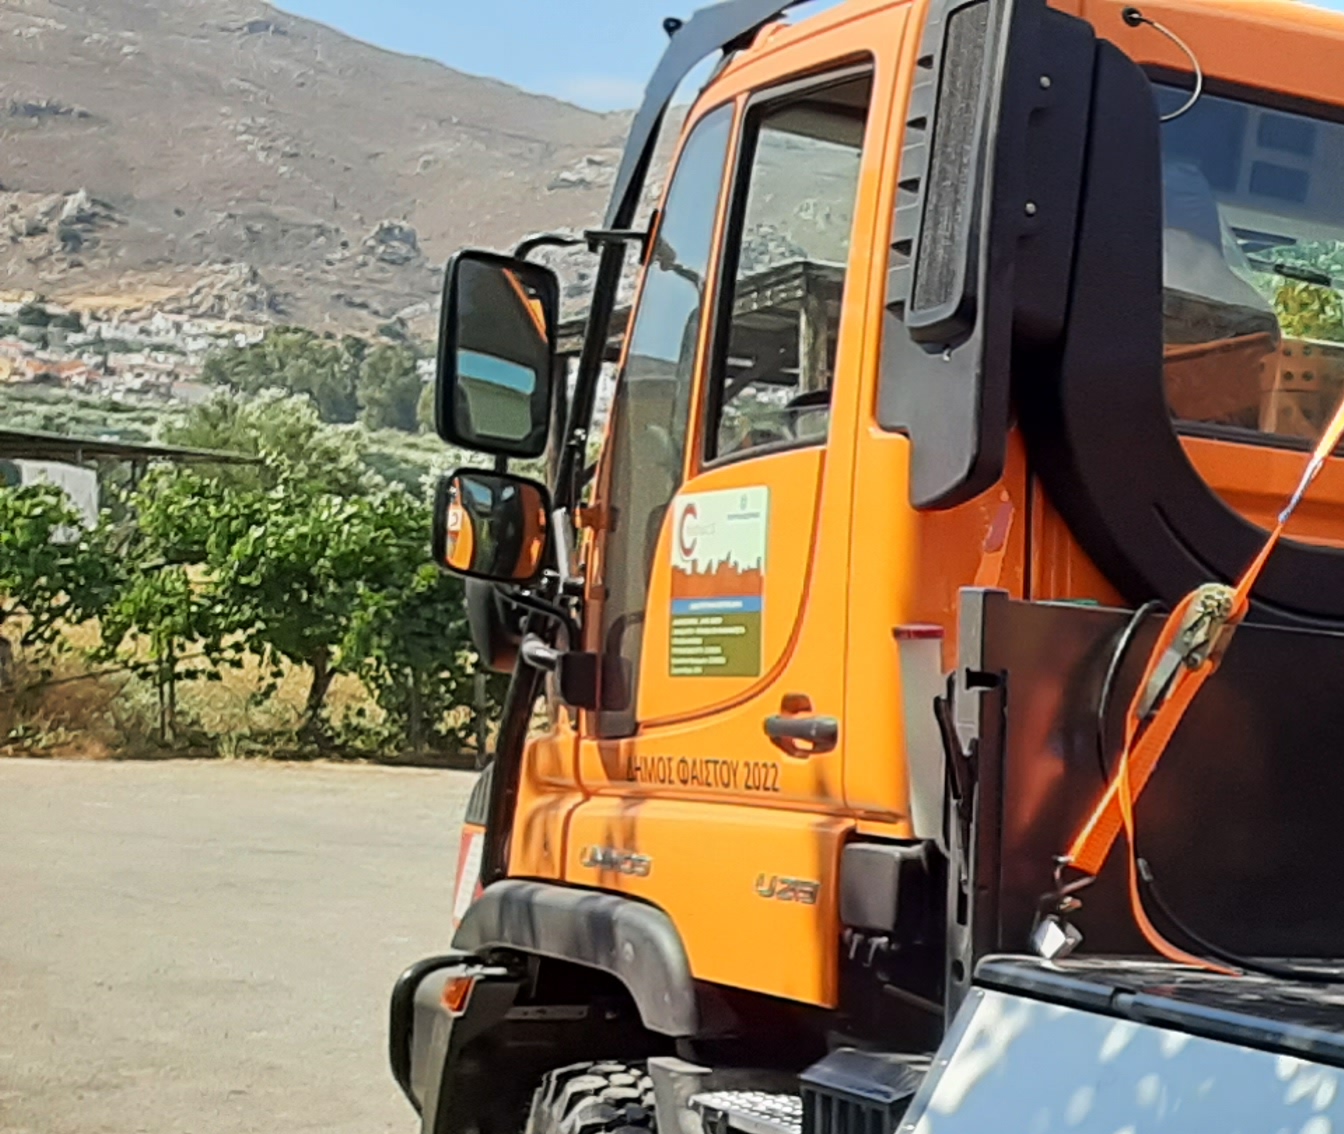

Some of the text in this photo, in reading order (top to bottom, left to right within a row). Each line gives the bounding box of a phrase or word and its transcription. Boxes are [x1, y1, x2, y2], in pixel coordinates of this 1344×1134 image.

[626, 755, 780, 792] ΔΗΜΟΣ ΦΑΙΣΤΟΥ 2022
